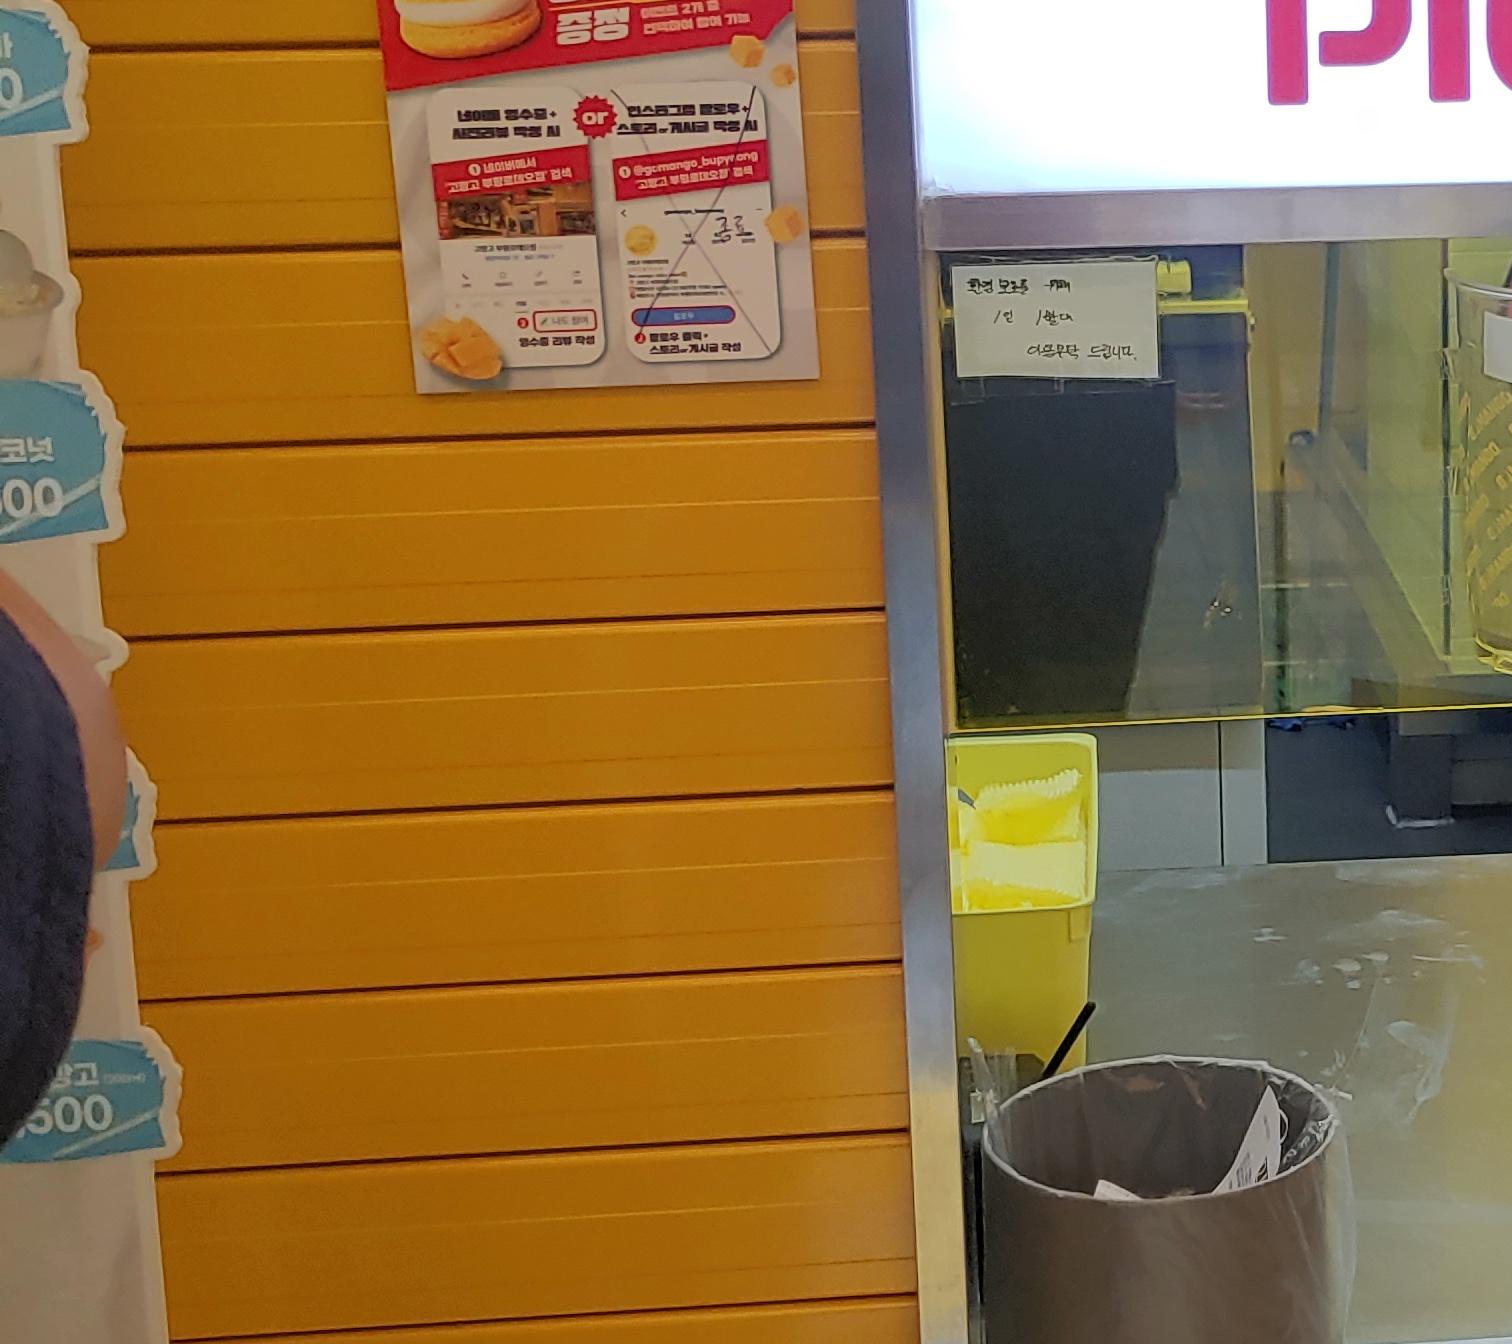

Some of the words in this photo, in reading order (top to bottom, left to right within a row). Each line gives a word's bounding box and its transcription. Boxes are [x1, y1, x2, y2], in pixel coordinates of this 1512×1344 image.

[555, 7, 631, 46] 증정
[582, 111, 609, 125] or
[0, 477, 63, 518] 00
